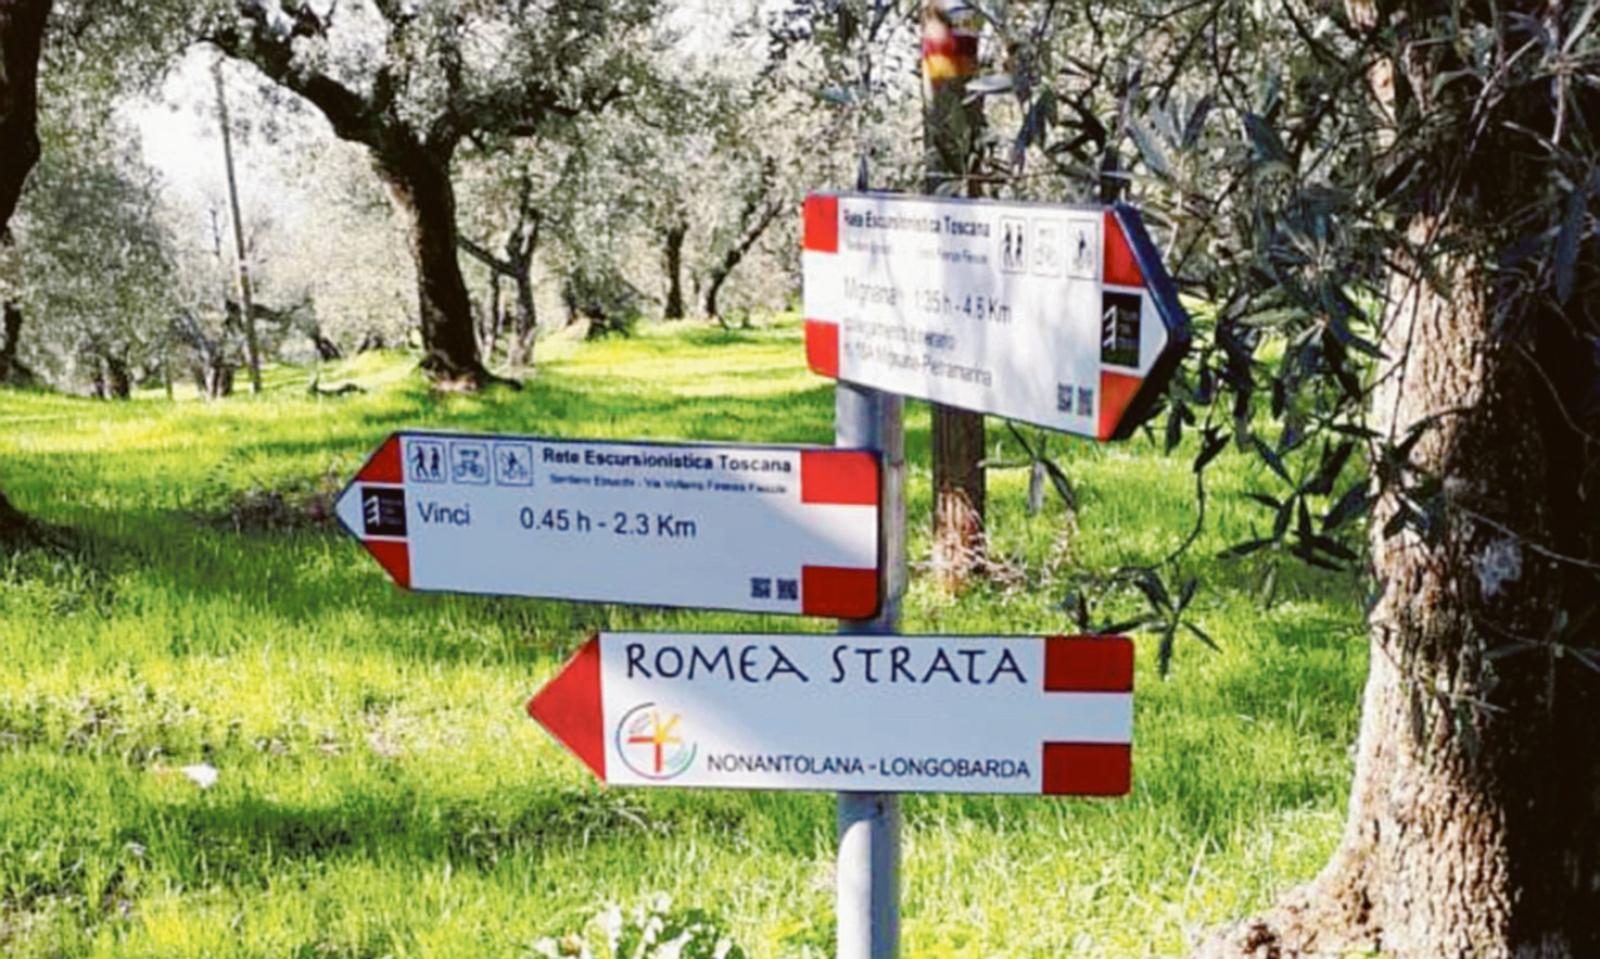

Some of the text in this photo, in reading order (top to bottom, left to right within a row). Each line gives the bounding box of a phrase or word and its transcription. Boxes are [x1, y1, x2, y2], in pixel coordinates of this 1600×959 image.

[944, 215, 991, 238] Toscana
[988, 296, 1012, 324] Km
[543, 448, 792, 473] Rete Escursionistica Toscana
[418, 501, 471, 526] Vinci
[520, 506, 571, 531] 0.45
[577, 511, 591, 532] h
[614, 511, 650, 535] 2.3
[657, 515, 697, 538] Km
[626, 643, 1027, 685] ROMEA STRATA
